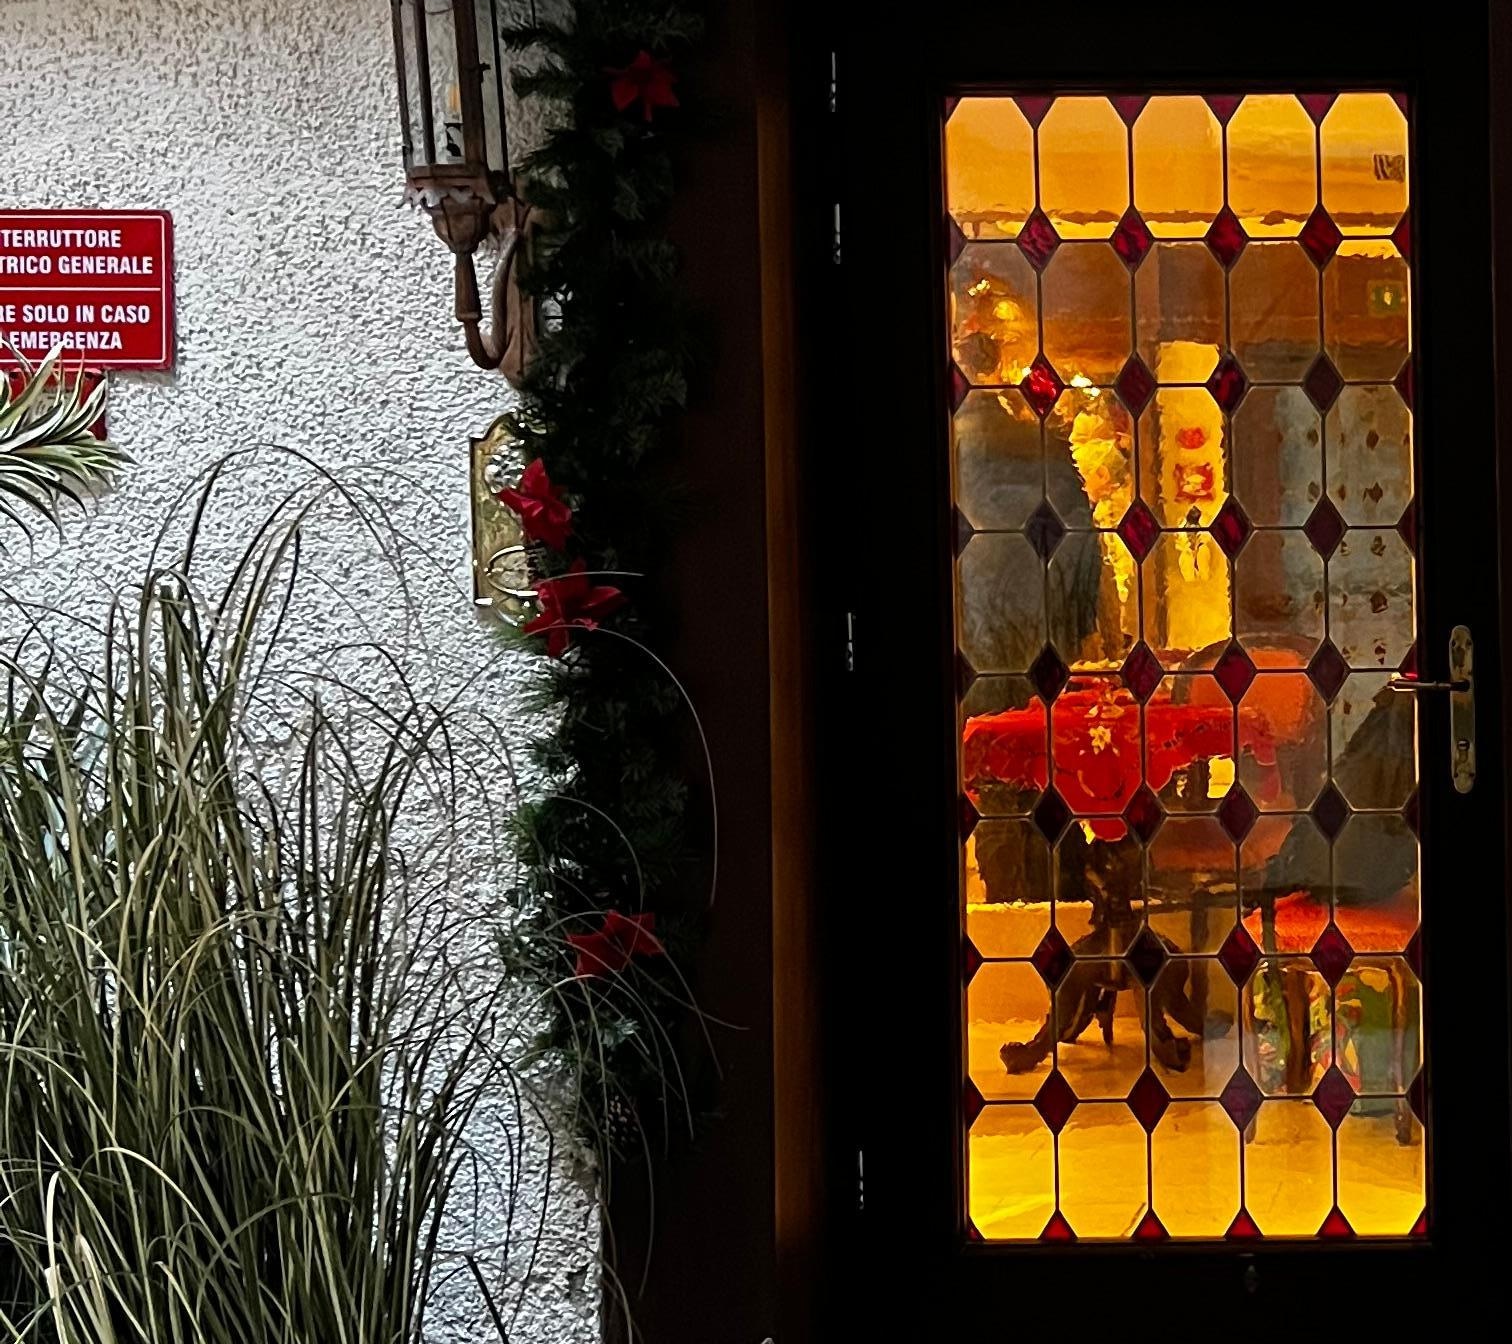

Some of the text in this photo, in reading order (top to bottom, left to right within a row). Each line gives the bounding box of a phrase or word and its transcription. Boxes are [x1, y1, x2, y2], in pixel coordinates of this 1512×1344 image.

[58, 256, 153, 274] GENERALE
[0, 305, 151, 324] E SOLO IN CASO
[10, 331, 122, 350] EMERGENZA
